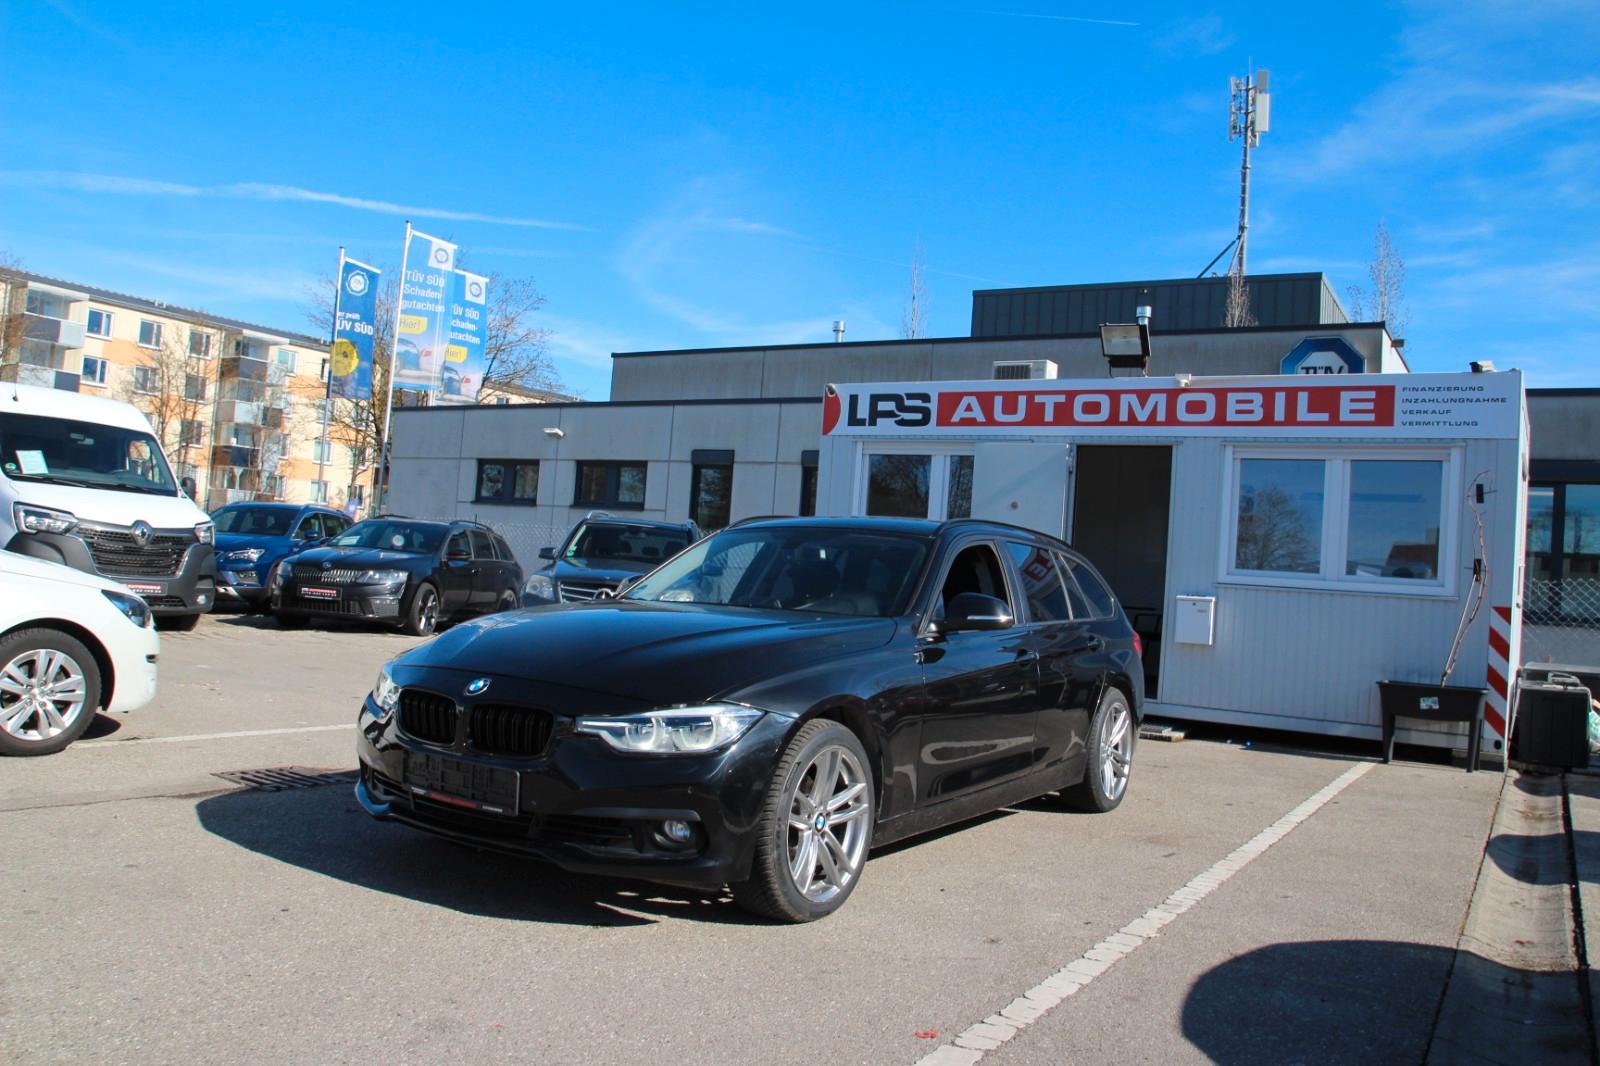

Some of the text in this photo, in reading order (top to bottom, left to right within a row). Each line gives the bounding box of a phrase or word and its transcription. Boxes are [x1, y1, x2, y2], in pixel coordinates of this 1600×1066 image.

[337, 317, 374, 335] ÜV SÜD
[449, 330, 480, 344] utachten
[1402, 385, 1485, 393] FINANZIERUNG
[847, 390, 1377, 428] LPS AUTOMOBILE
